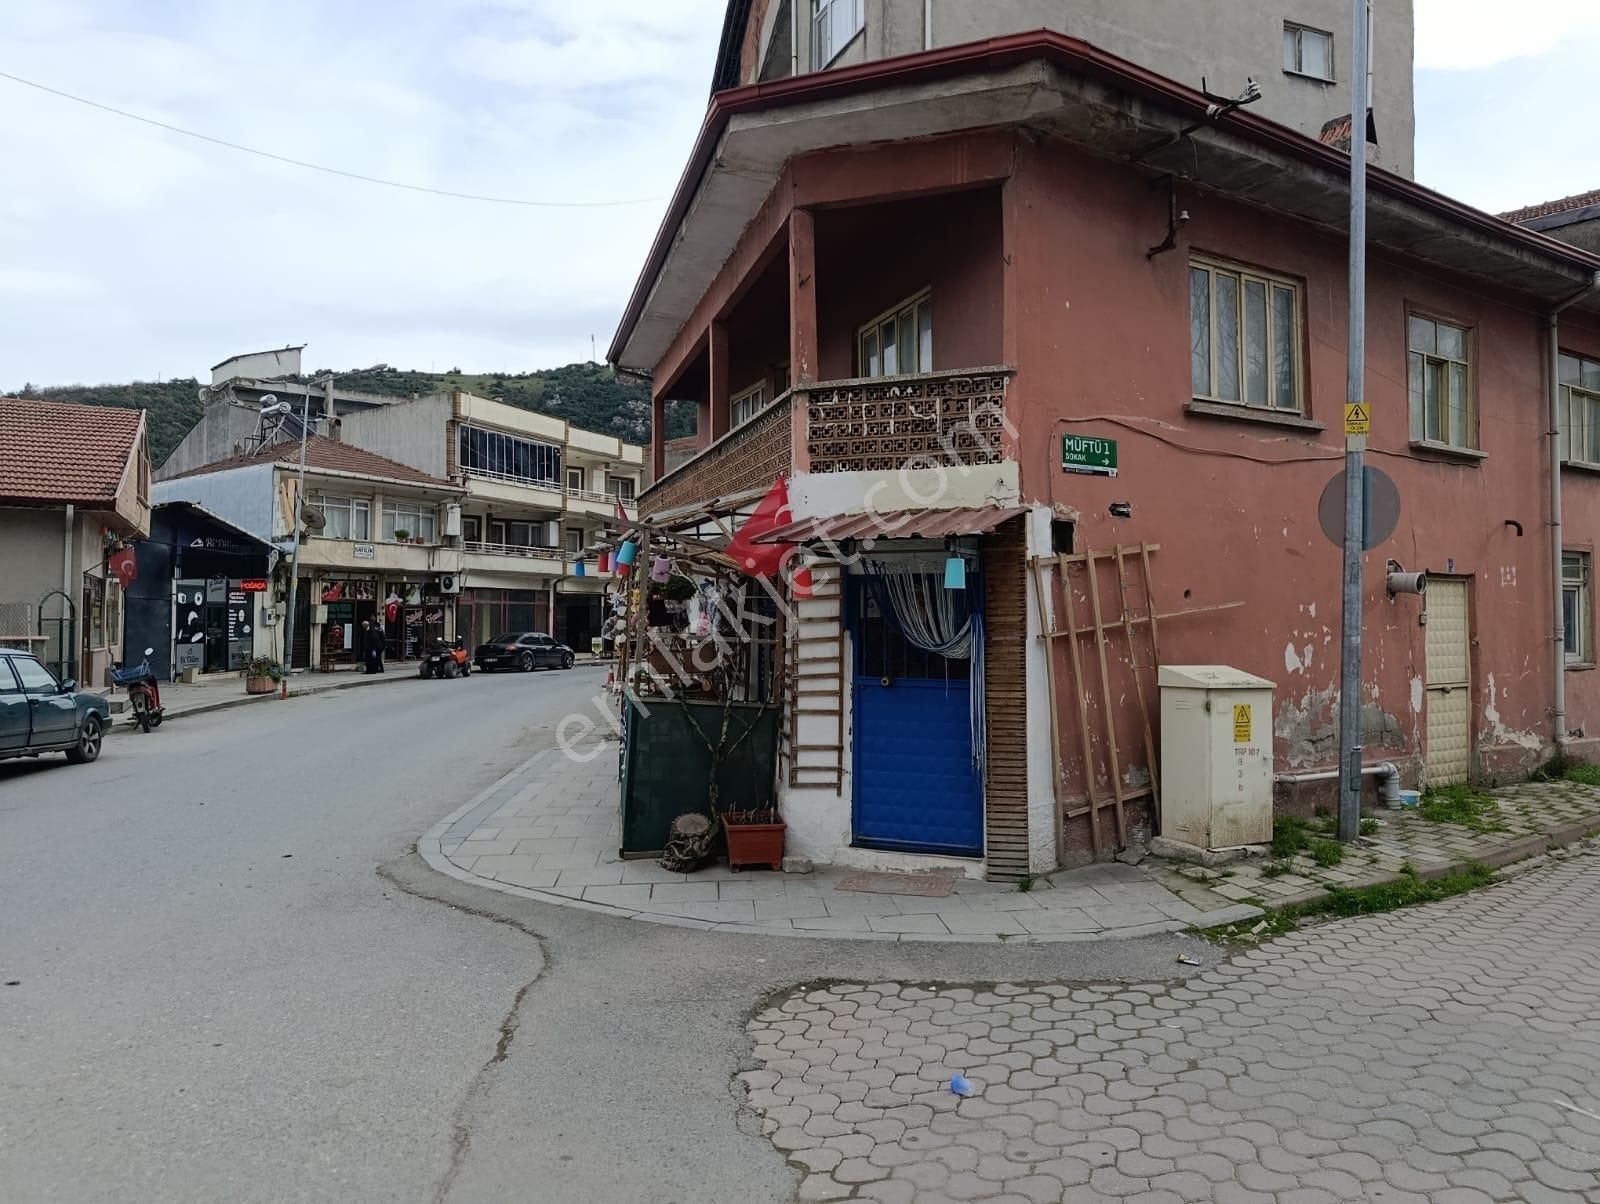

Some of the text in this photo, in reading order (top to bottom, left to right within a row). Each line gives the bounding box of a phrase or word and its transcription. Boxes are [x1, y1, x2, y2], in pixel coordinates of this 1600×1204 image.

[1065, 436, 1110, 455] MÜFTÜ 1
[1065, 452, 1087, 462] SOKAK
